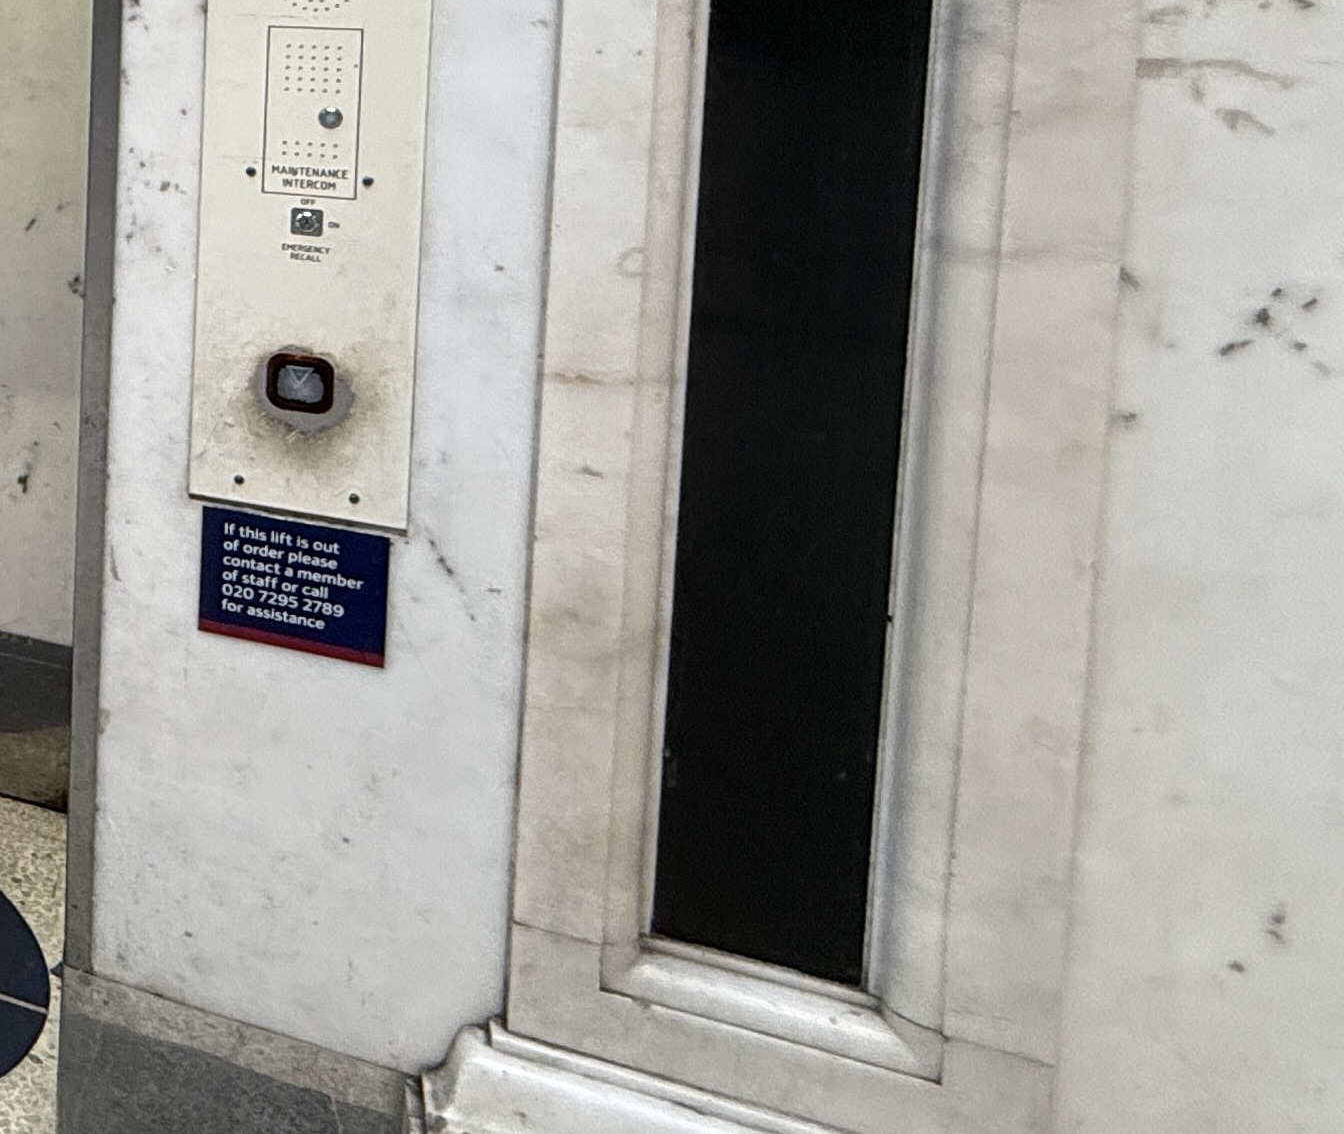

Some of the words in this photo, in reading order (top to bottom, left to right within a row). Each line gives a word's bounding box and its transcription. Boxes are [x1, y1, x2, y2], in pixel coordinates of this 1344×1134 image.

[272, 165, 349, 180] MAINTENANCE
[282, 178, 337, 191] INTERCOM
[281, 243, 331, 255] EMERGENCY
[290, 252, 321, 263] RECALL
[224, 523, 236, 536] If
[238, 525, 267, 542] this
[270, 531, 293, 547] lift
[296, 535, 309, 548] is
[313, 540, 340, 554] out
[223, 539, 239, 552] of
[242, 543, 284, 561] order
[288, 549, 338, 570] please
[222, 569, 239, 583] of
[242, 573, 278, 591] staff
[281, 582, 298, 593] or
[302, 584, 329, 600] call
[223, 555, 281, 577] contact
[285, 567, 293, 577] a
[297, 569, 364, 590] member
[221, 598, 244, 613] for
[246, 606, 326, 630] assistance
[222, 584, 254, 601] 020
[258, 590, 298, 608] 7295
[302, 598, 344, 618] 2789
